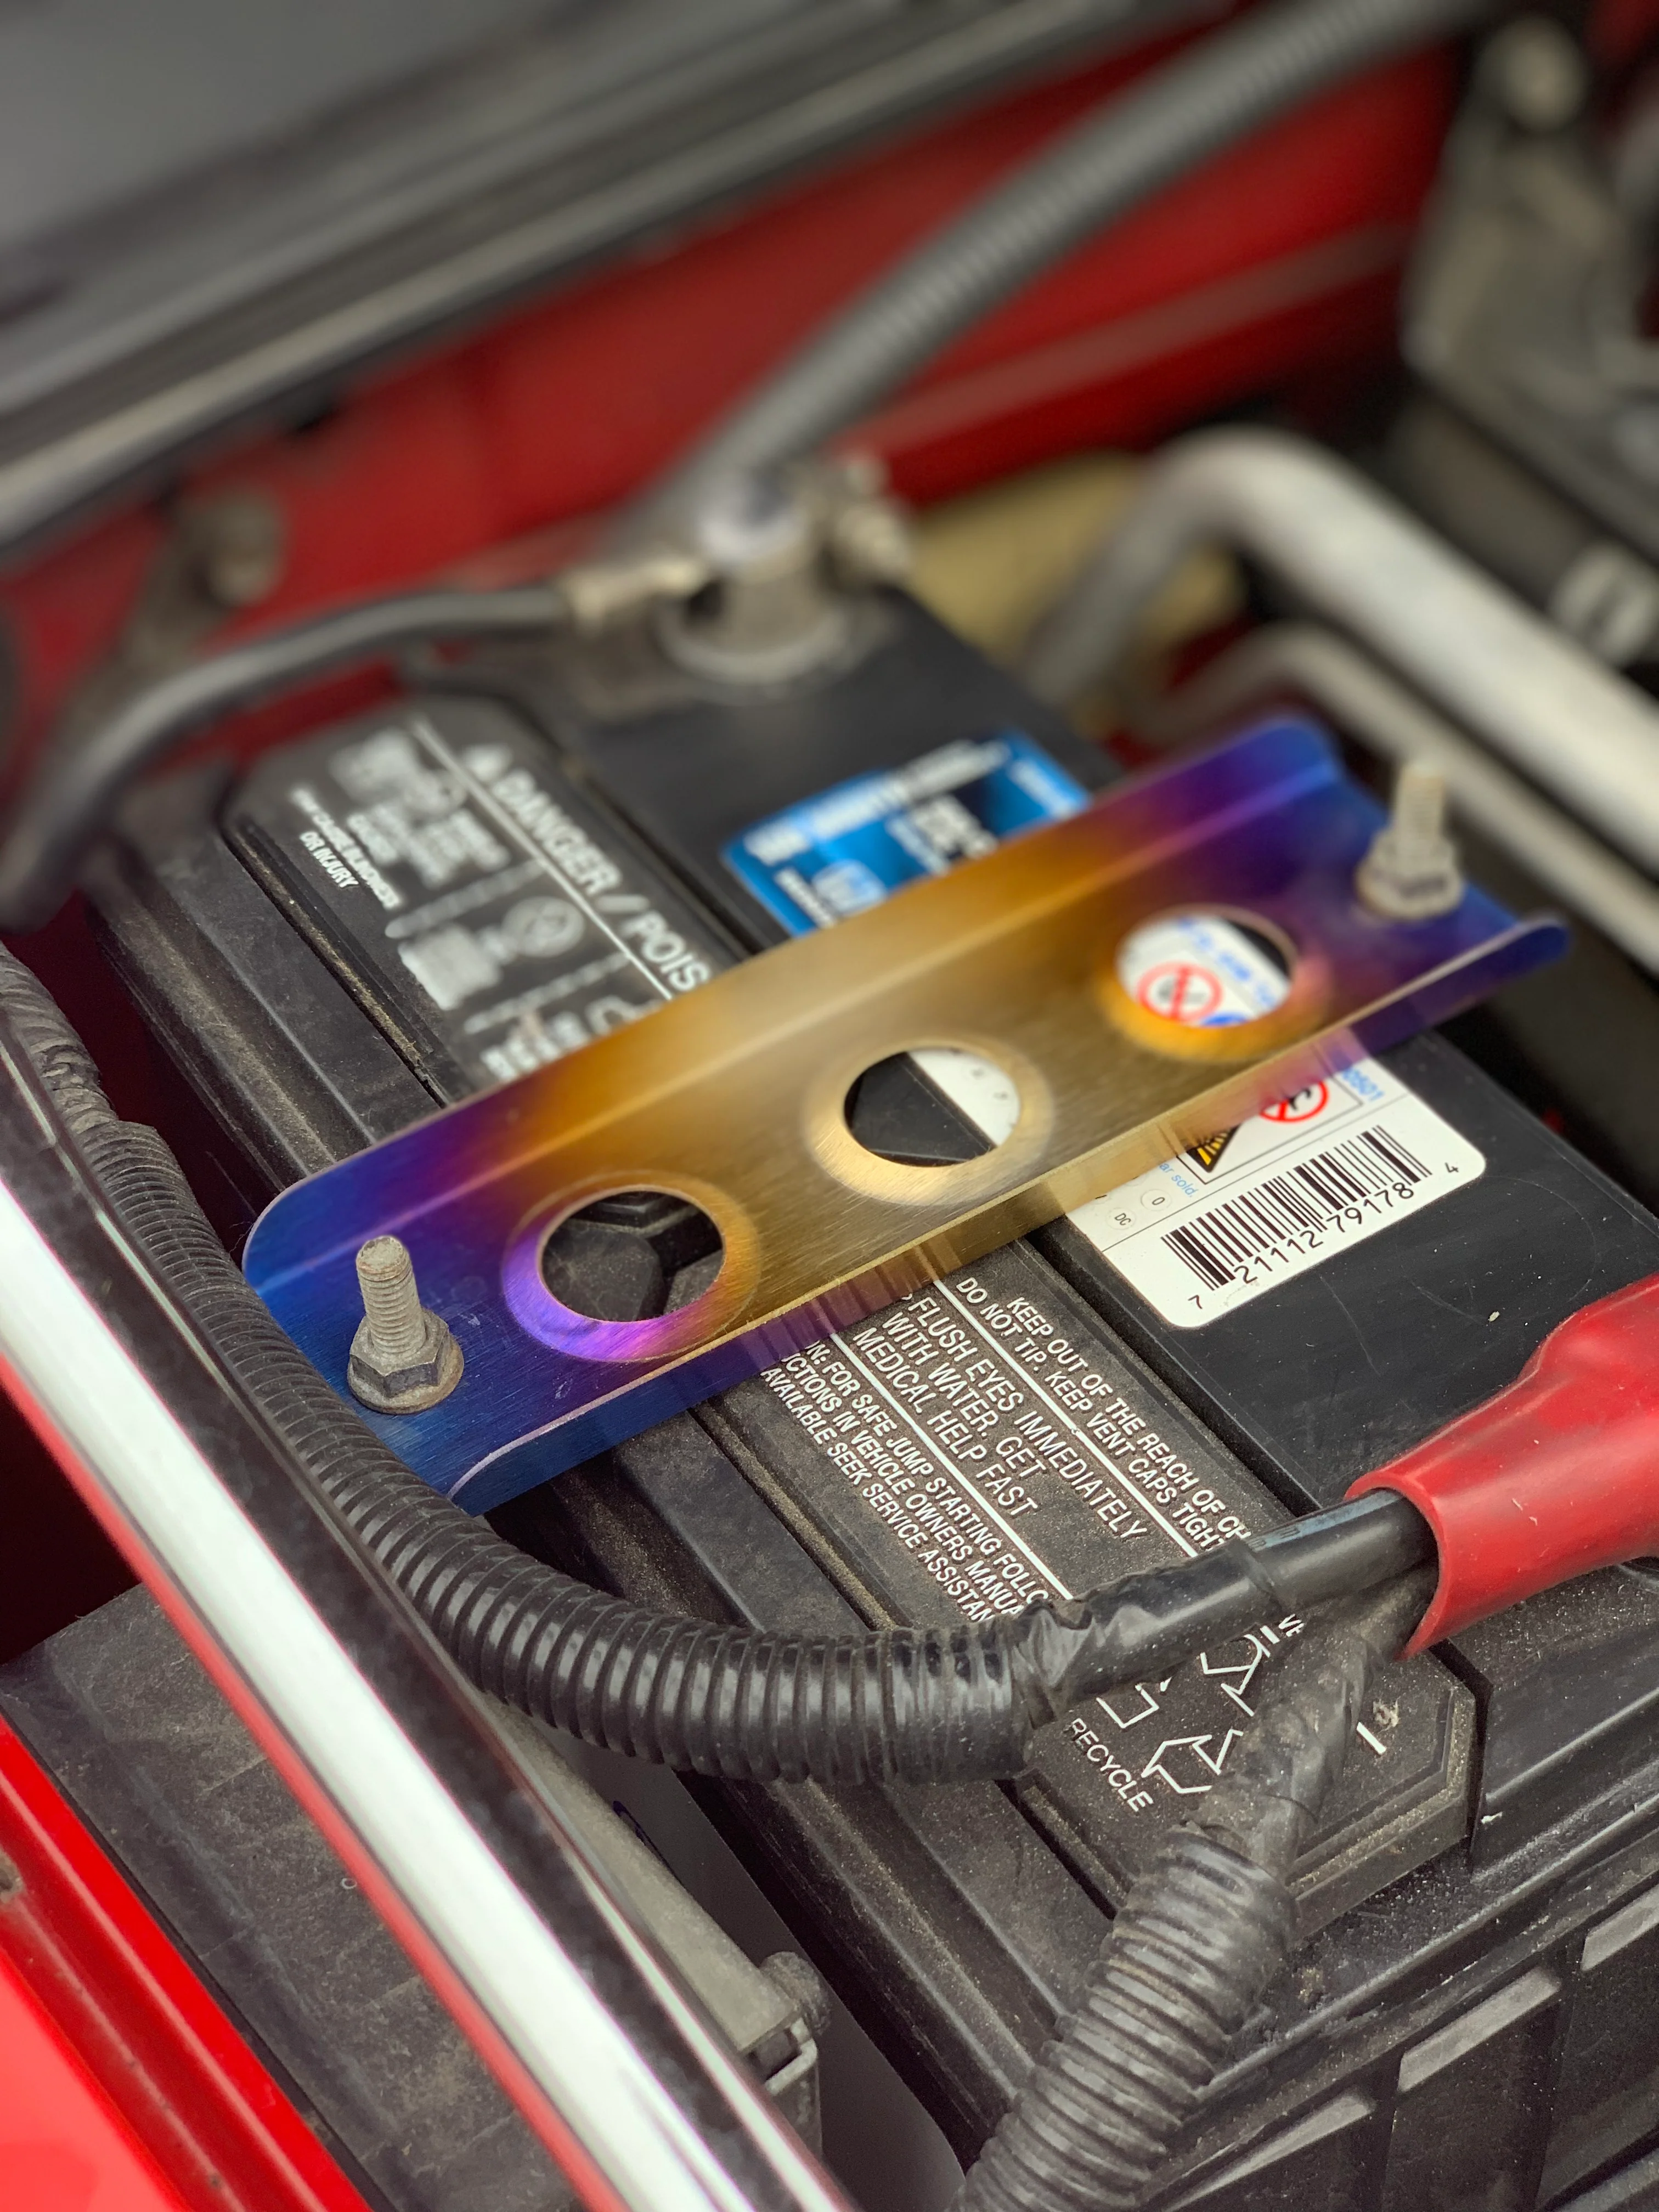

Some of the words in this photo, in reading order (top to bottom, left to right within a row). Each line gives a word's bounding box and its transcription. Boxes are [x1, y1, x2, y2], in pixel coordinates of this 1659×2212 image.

[300, 831, 325, 851] OR
[313, 848, 358, 888] INJURY
[1114, 1213, 1131, 1226] DC
[1171, 1174, 1198, 1198] sold.
[1233, 1231, 1323, 1285] 21112
[1326, 1181, 1415, 1233] 79178
[1443, 1161, 1460, 1176] 4
[760, 1368, 838, 1443] AVAILABLE
[827, 1439, 872, 1485] SEEK
[862, 1483, 928, 1548] SERVICE
[805, 1340, 831, 1365] N:
[822, 1361, 861, 1397] FOR
[852, 1394, 897, 1436] SAFE
[886, 1437, 934, 1475] JUMP
[926, 1477, 1002, 1555] STARTING
[853, 1327, 936, 1414] MEDICAL
[927, 1410, 986, 1459] HELP
[976, 1464, 1038, 1515] FAST
[882, 1312, 939, 1365] WITH
[928, 1362, 998, 1437] WATER.
[996, 1436, 1046, 1477] GET
[908, 1296, 979, 1361] FLUSH
[964, 1358, 1026, 1414] EYES
[1014, 1410, 1147, 1538] IMMEDIATELY
[956, 1277, 988, 1304] DO
[980, 1301, 1024, 1338] NOT
[1014, 1338, 1047, 1372] TIP.
[1044, 1373, 1094, 1414] KEEP
[1087, 1411, 1136, 1455] VENT
[1128, 1459, 1177, 1503] CAPS
[1006, 1297, 1053, 1337] KEEP
[1047, 1339, 1088, 1374] OUT
[1081, 1373, 1113, 1398] OF
[1105, 1396, 1146, 1435] THE
[1137, 1433, 1199, 1491] REACH
[1192, 1489, 1226, 1513] OF
[832, 1411, 861, 1433] IN
[851, 1430, 916, 1494] VEHICLE
[905, 1493, 973, 1561] OWNERS
[1070, 1718, 1153, 1811] RECYCLE
